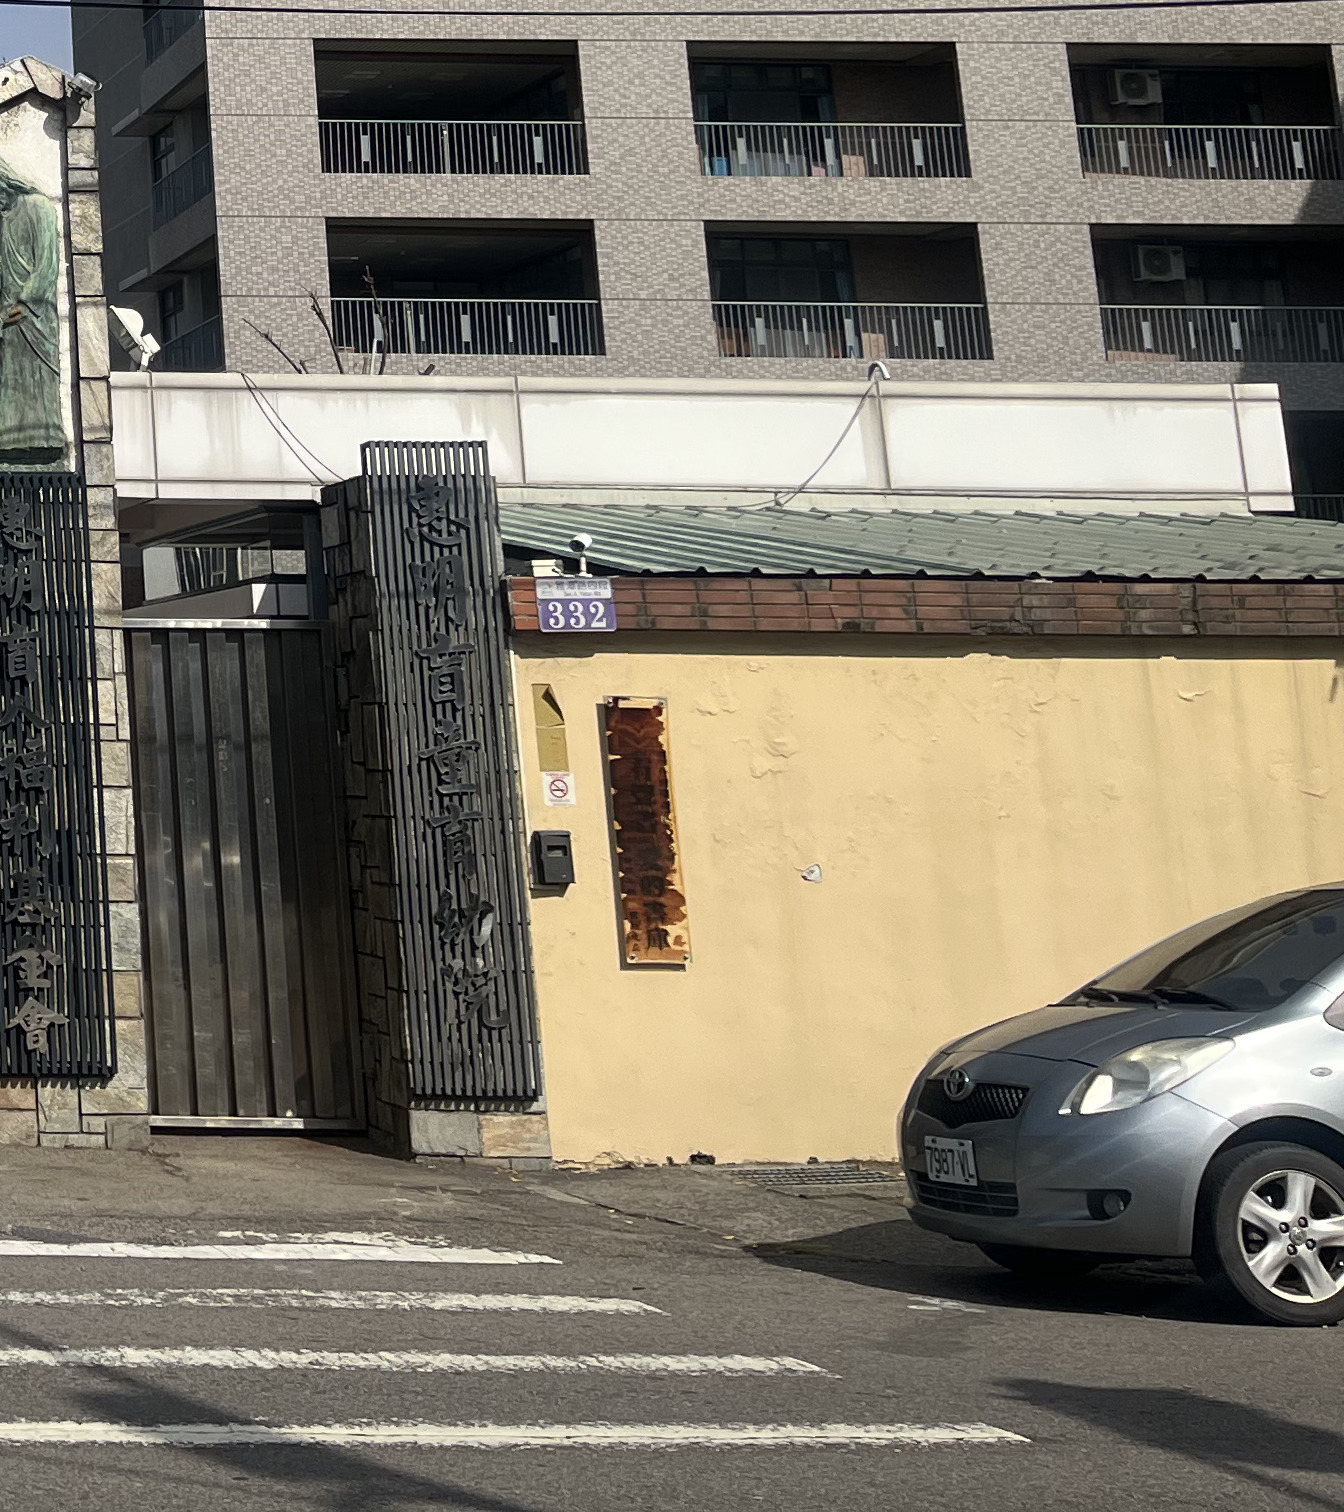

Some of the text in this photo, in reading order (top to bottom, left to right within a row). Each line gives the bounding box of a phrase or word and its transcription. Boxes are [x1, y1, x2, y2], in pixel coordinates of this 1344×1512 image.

[402, 473, 510, 1031] 惠明盲童育幼院
[548, 601, 607, 629] 332
